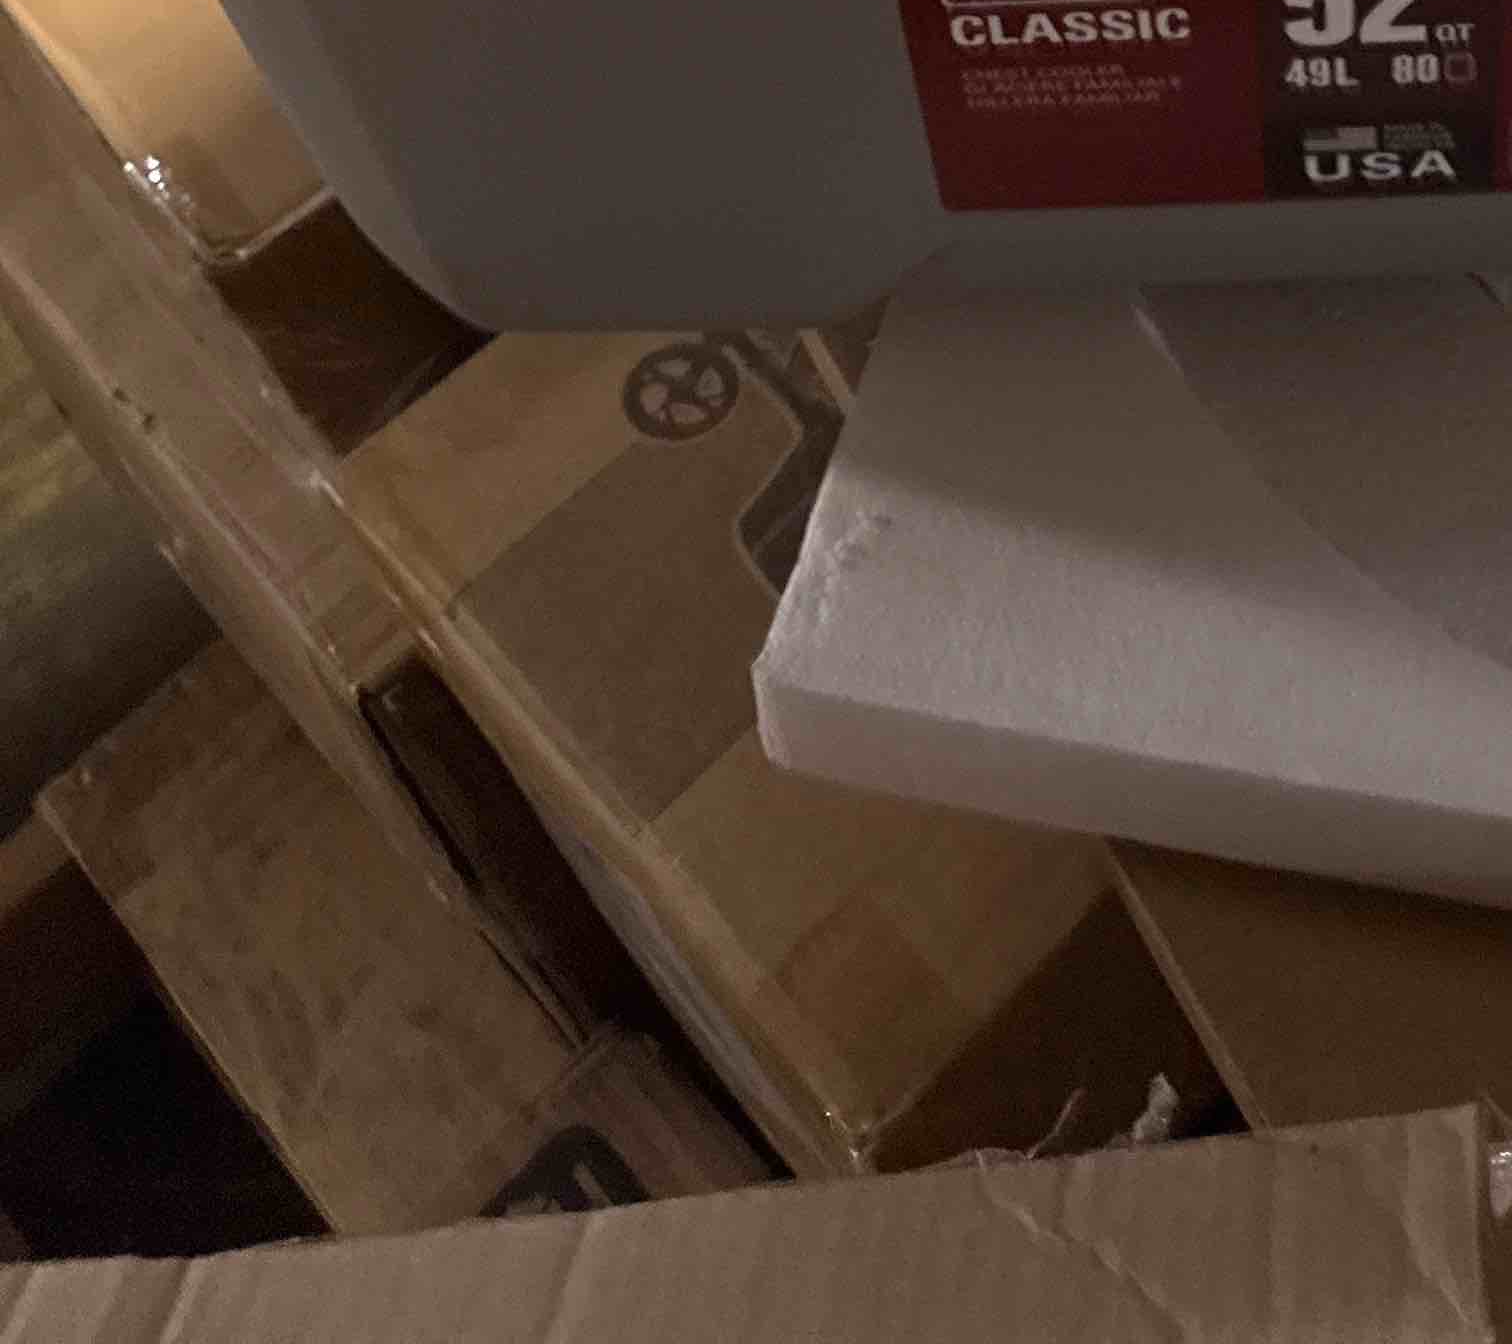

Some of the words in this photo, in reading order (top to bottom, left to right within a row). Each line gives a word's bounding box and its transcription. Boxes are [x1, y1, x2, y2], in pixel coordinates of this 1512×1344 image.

[950, 6, 1191, 46] CLASSIC
[1434, 22, 1477, 43] QT
[1282, 55, 1361, 88] 49L
[1391, 52, 1441, 86] 80
[1302, 149, 1458, 183] USA
